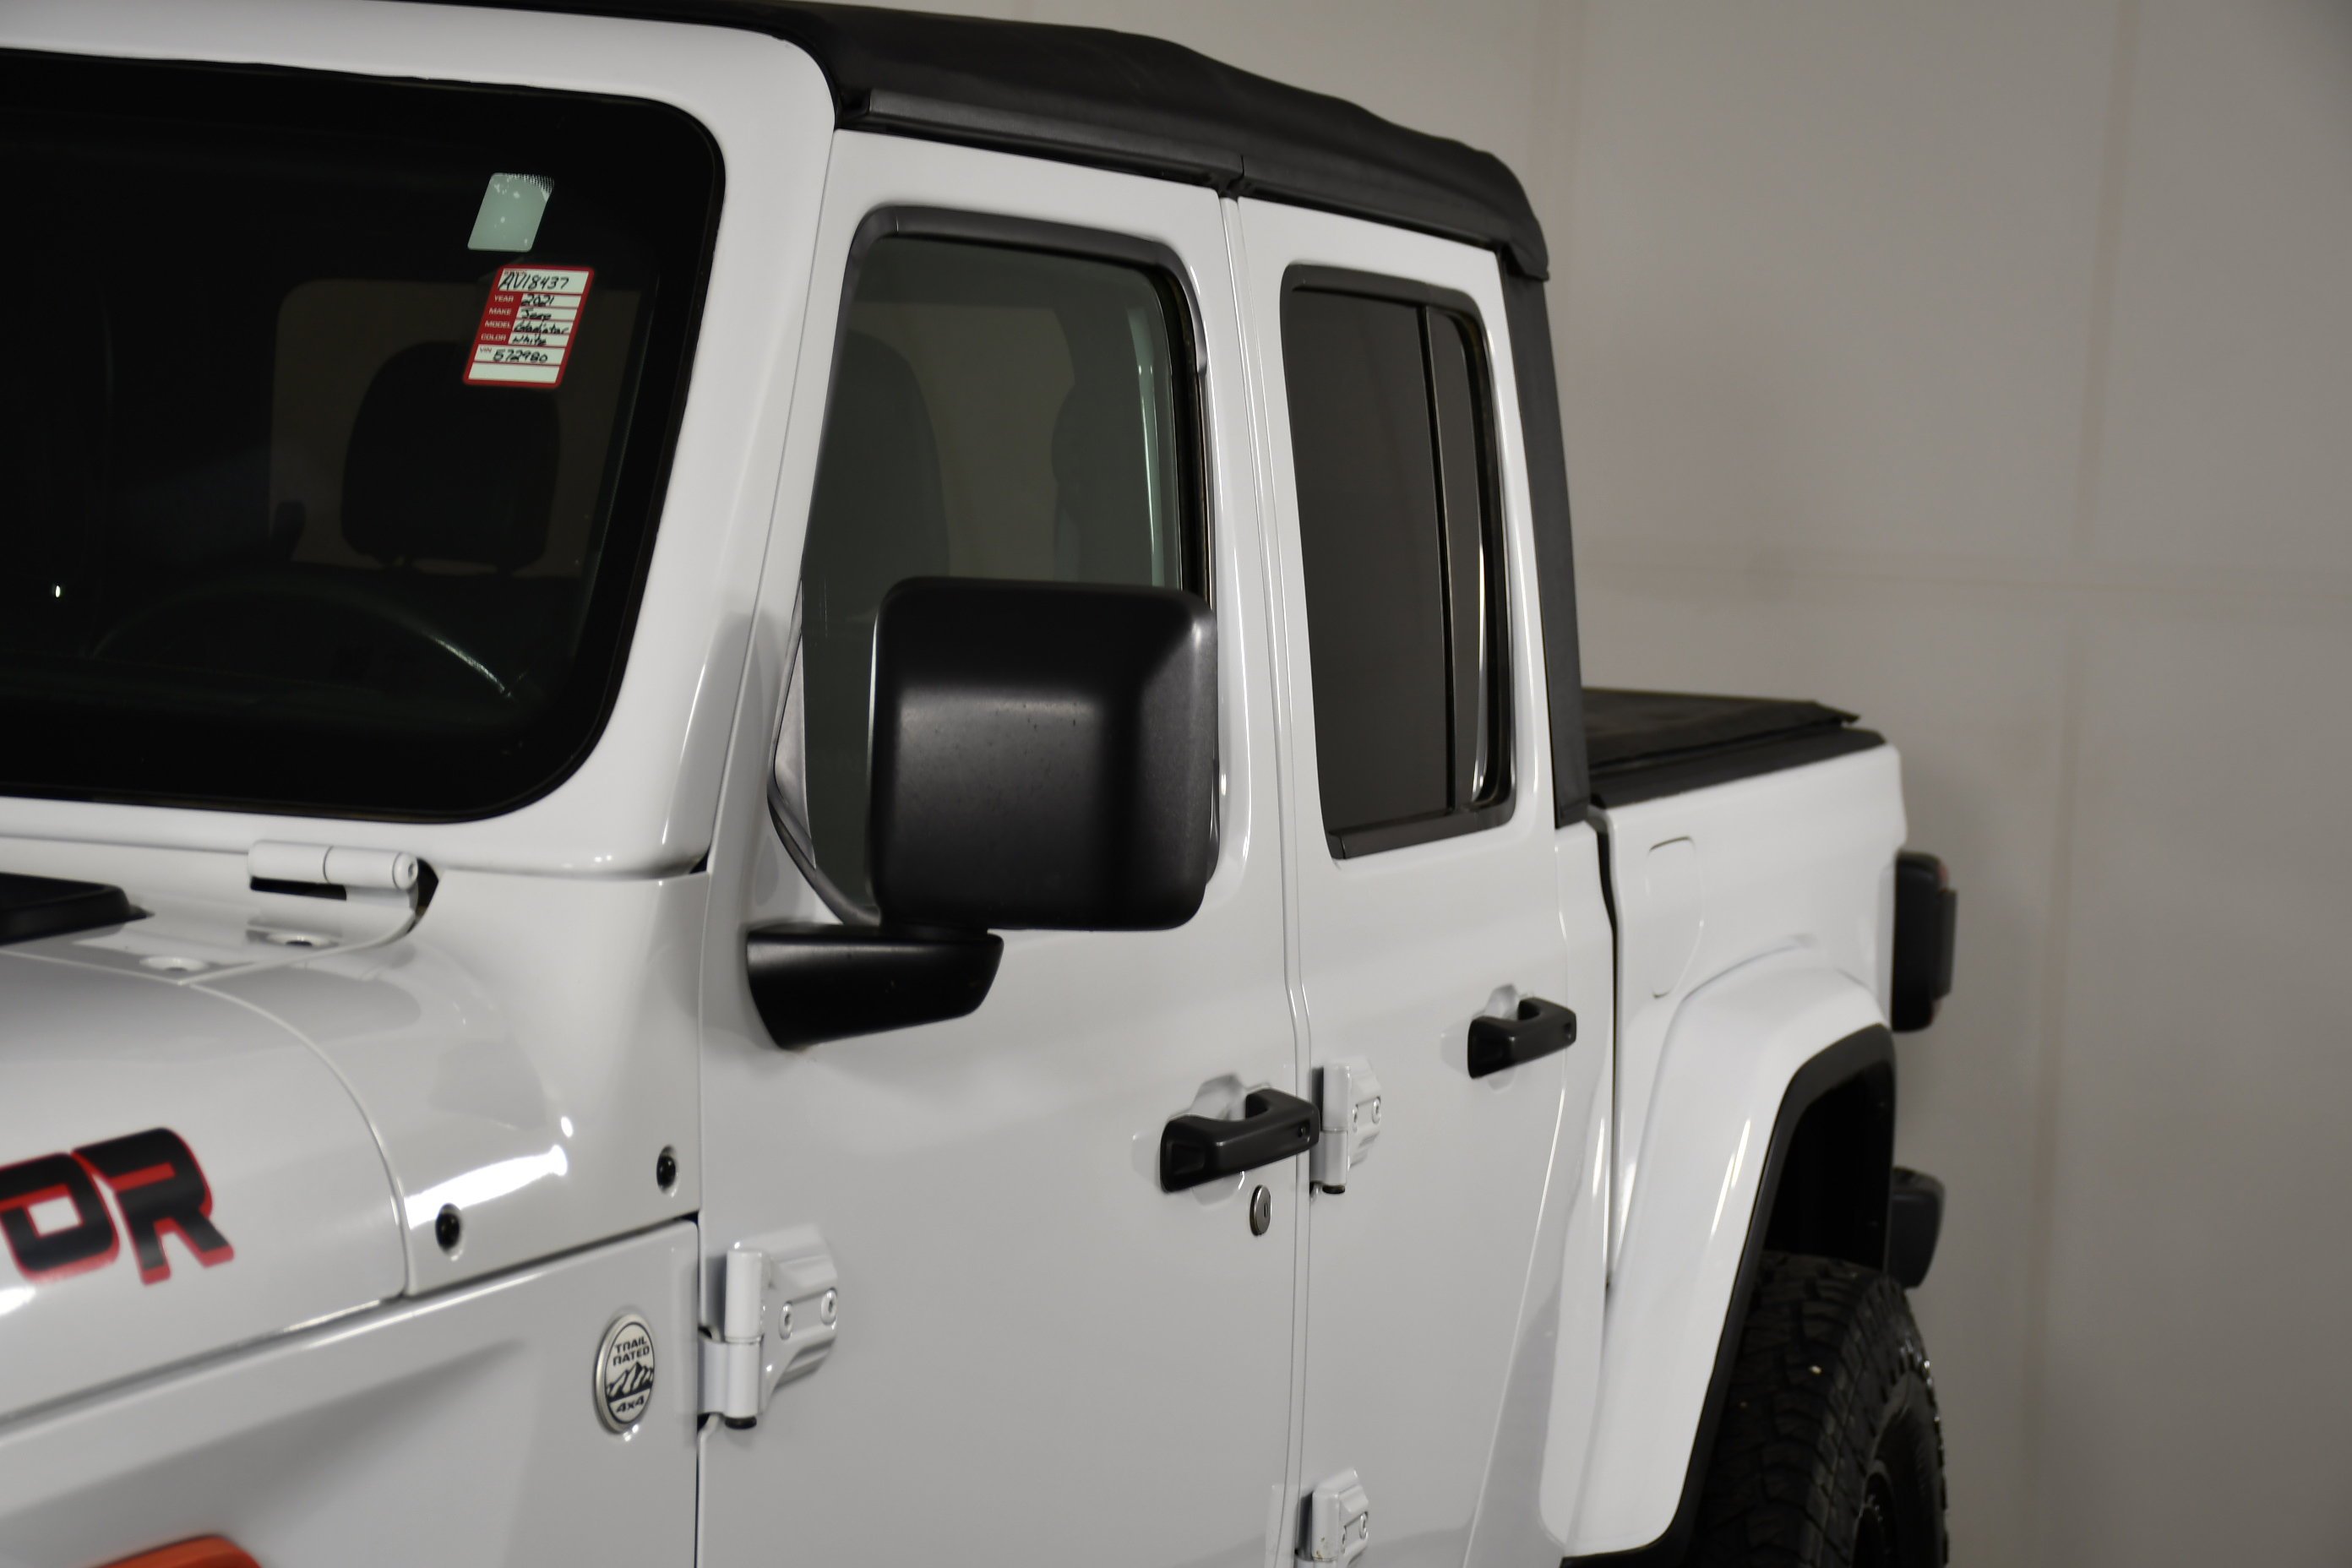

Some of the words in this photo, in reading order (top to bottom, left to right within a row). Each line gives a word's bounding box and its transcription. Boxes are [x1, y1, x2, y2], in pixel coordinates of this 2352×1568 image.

[521, 293, 554, 307] 2021
[520, 308, 552, 321] Jeep
[485, 320, 511, 329] MODEL
[481, 333, 507, 341] COLOR
[493, 348, 548, 362] 572980
[615, 1336, 647, 1354] TRAIL
[612, 1346, 651, 1366] RATED
[616, 1396, 645, 1413] 4x4
